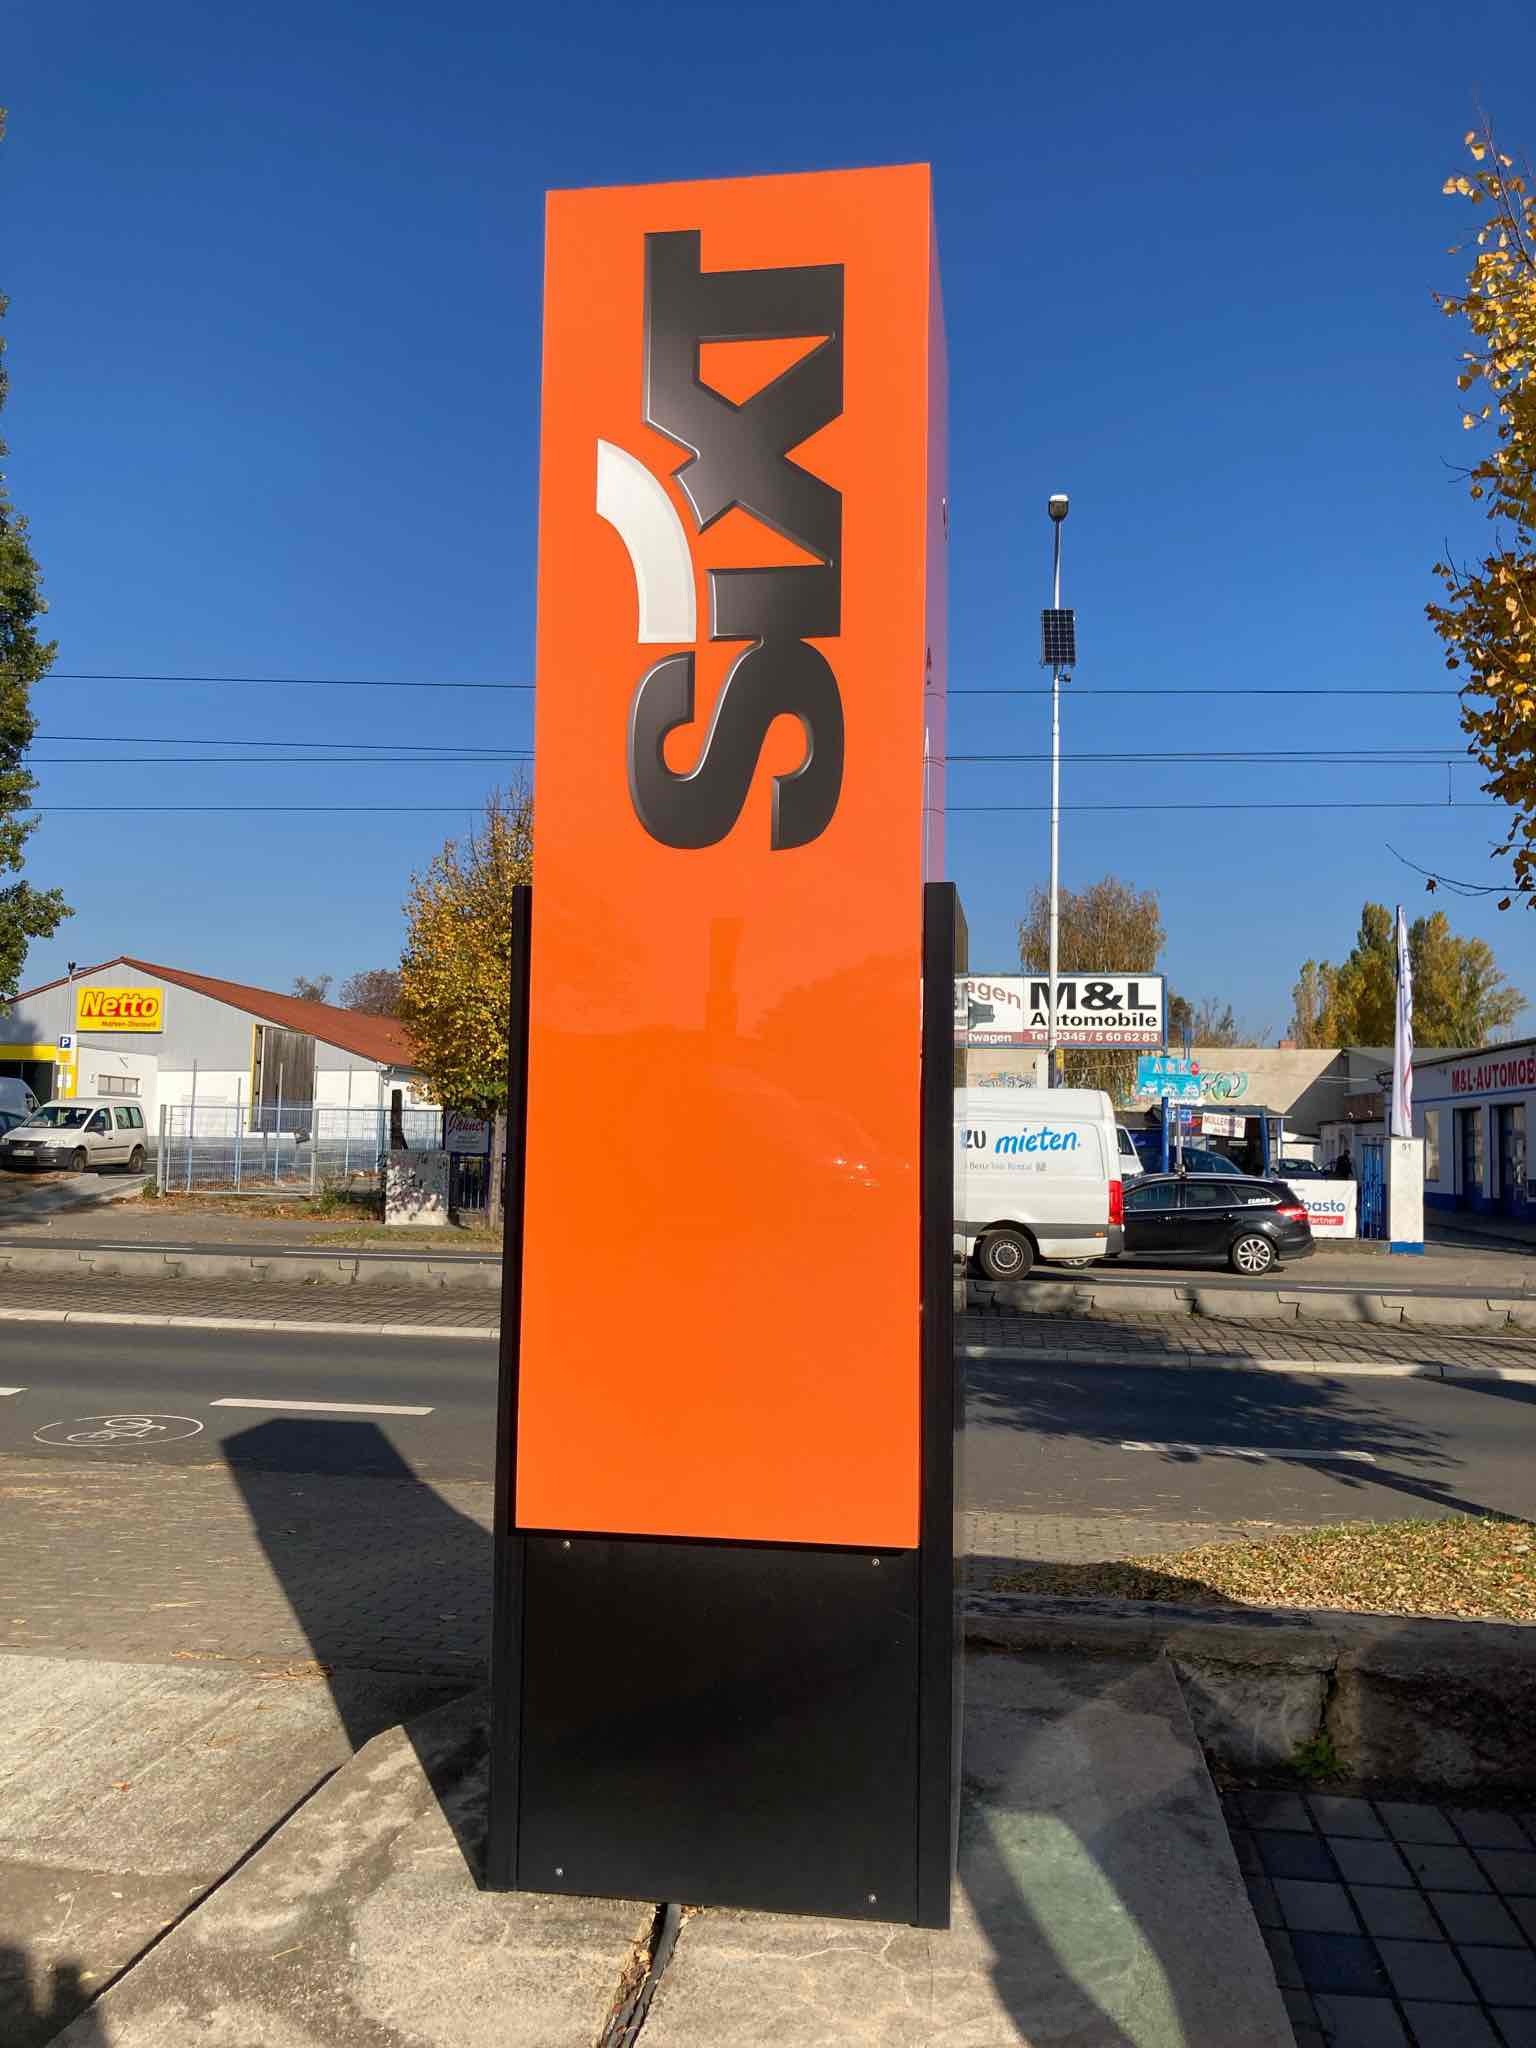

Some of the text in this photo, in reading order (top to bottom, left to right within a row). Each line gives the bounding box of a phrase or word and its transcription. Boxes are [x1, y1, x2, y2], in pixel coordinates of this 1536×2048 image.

[595, 229, 845, 852] SIXT
[81, 991, 159, 1017] Netto
[1030, 982, 1157, 1011] M&L
[1030, 1012, 1158, 1027] Atomobile
